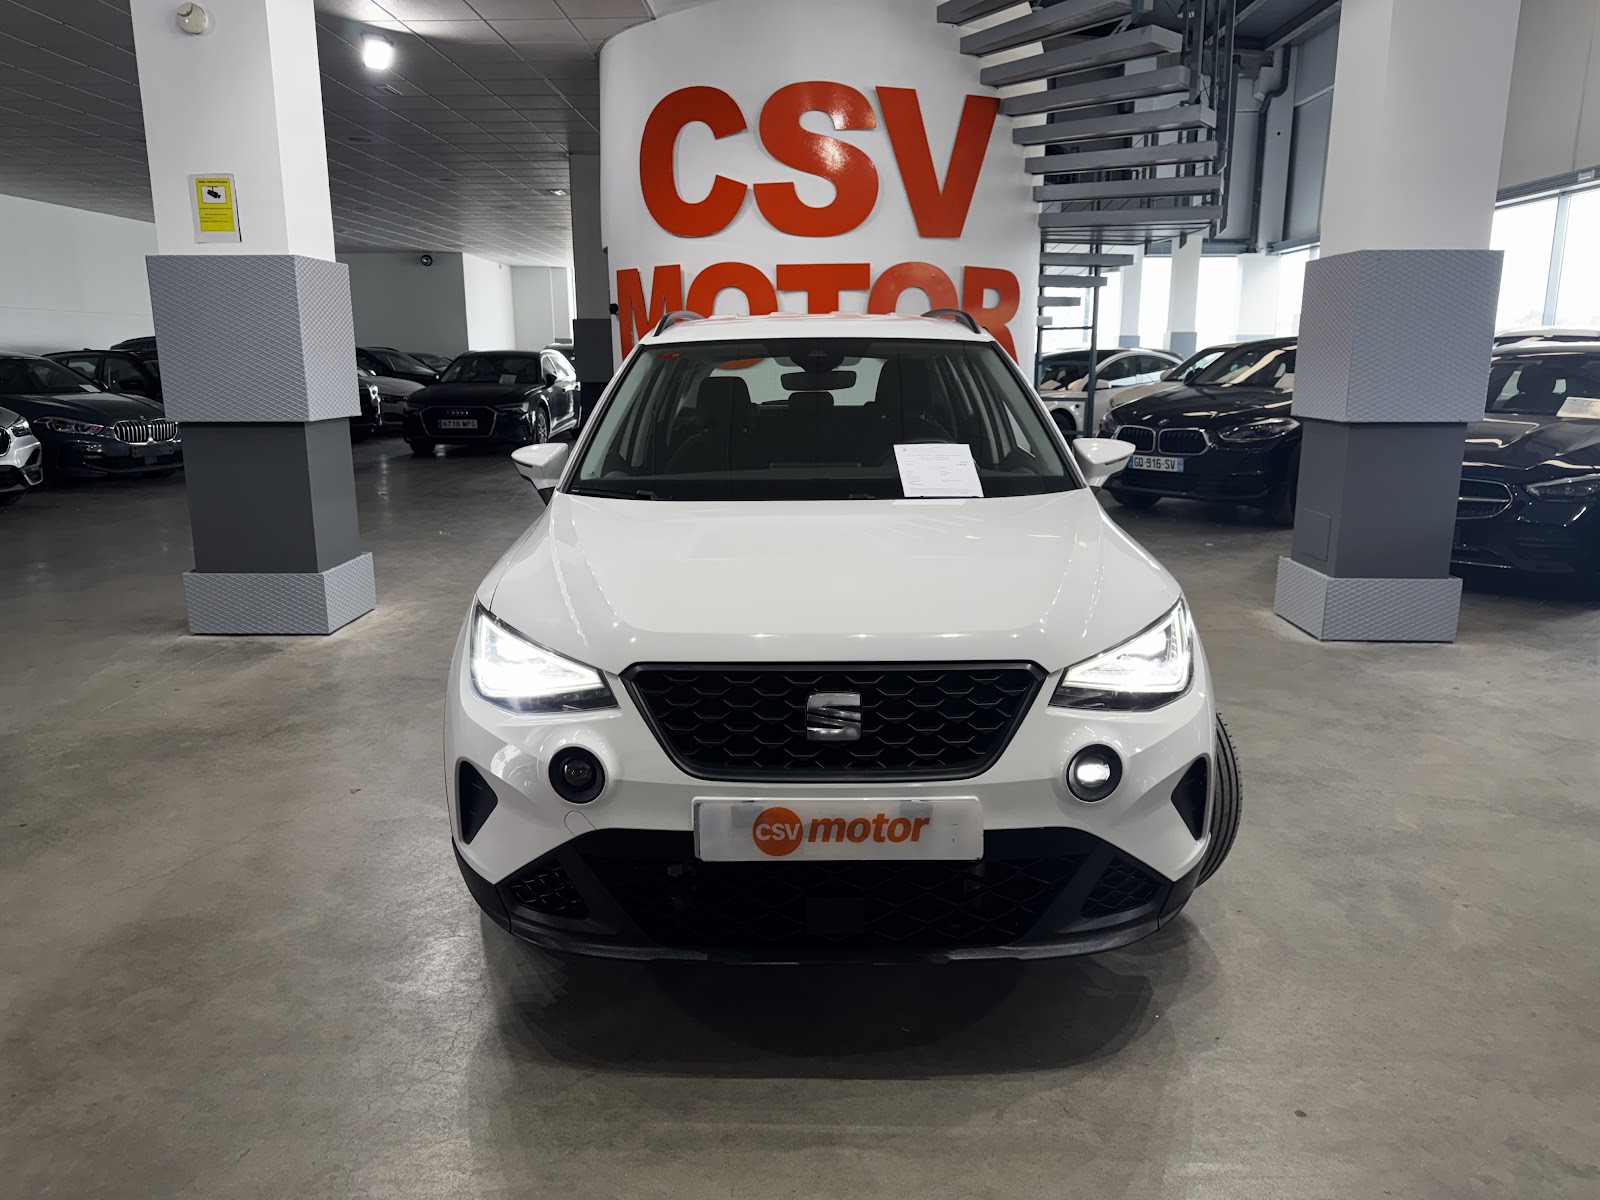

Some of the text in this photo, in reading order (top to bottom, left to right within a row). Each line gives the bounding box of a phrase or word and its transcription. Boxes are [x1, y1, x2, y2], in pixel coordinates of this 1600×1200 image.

[639, 80, 1001, 239] CSV
[755, 813, 931, 843] CSV motor
